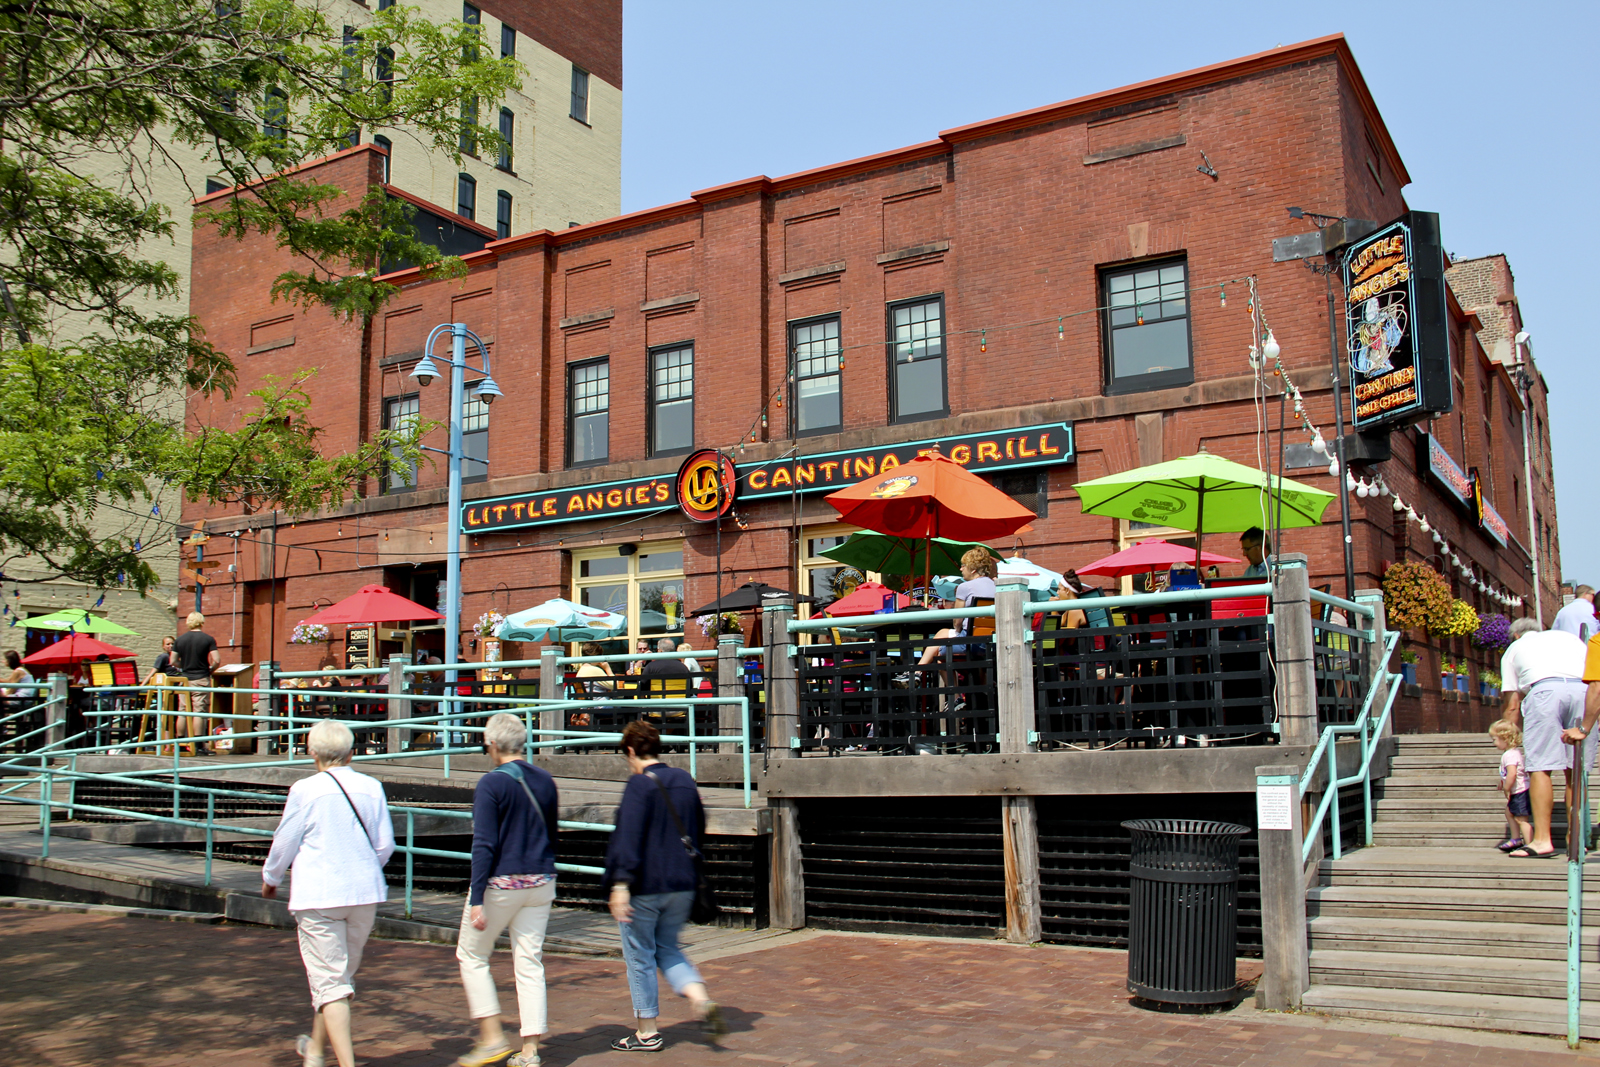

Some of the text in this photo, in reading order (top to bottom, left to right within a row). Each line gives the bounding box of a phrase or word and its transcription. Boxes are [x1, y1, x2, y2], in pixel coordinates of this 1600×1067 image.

[1350, 235, 1404, 275] LITTLE
[1349, 262, 1410, 304] ANGIE'S
[1355, 365, 1416, 401] CANTINA
[1356, 387, 1417, 418] AND GRILL
[748, 433, 1060, 490] CANTINA GRILL
[467, 479, 670, 526] LITTLE ANGIE'S
[690, 467, 720, 505] LA
